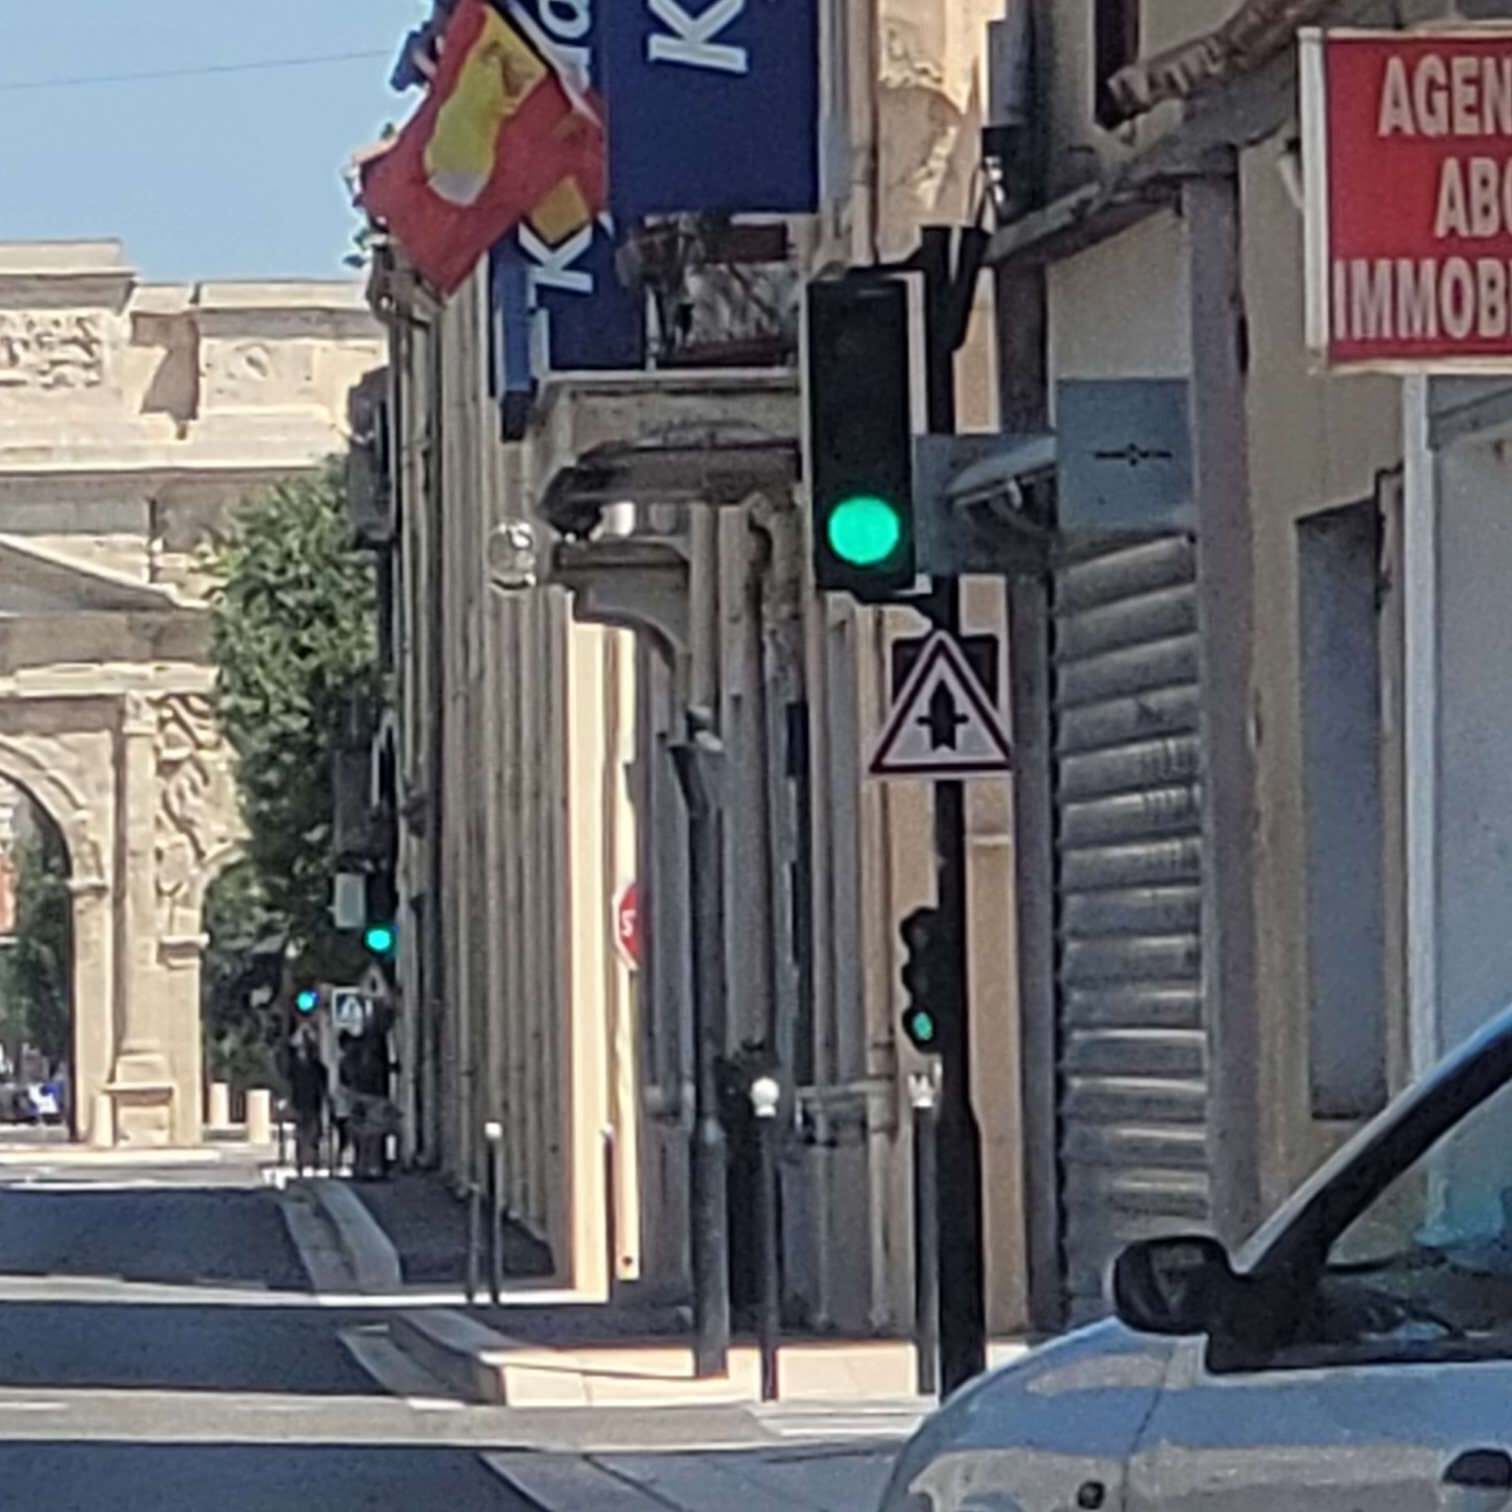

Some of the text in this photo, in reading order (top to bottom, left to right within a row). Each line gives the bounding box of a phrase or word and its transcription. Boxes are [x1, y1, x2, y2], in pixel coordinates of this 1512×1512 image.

[1377, 53, 1512, 138] AGEN
[1434, 156, 1512, 240] AB
[1333, 255, 1512, 341] IMMOB
